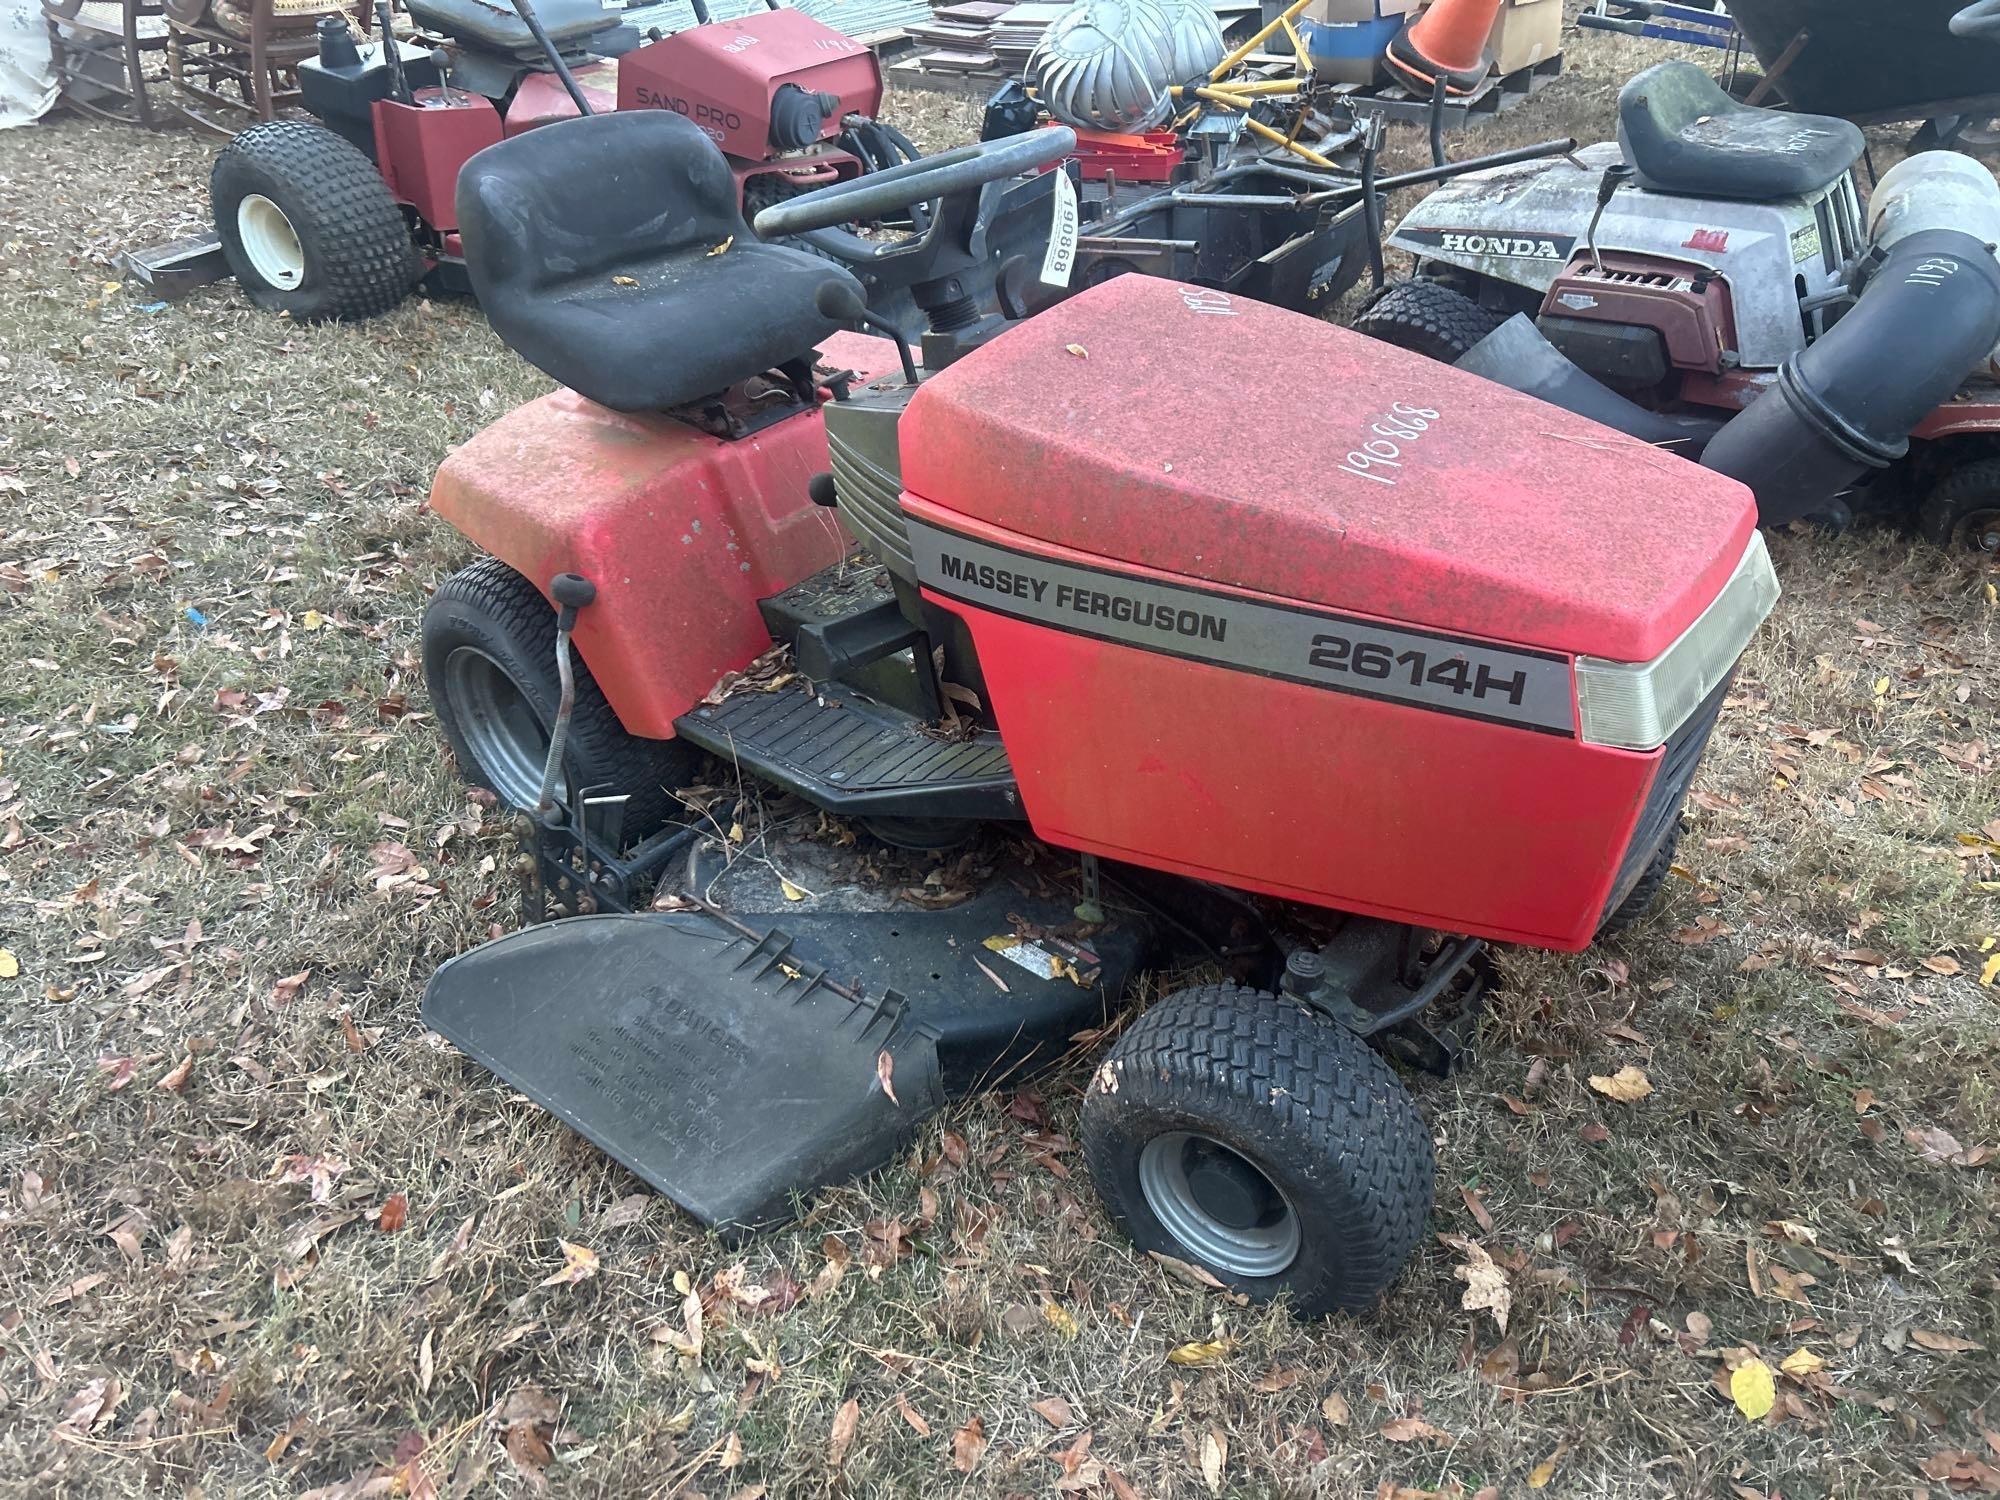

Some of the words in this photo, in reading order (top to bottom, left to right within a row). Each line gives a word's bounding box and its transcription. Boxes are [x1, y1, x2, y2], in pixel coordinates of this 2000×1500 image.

[636, 86, 690, 117] SAND
[695, 104, 741, 131] PRO
[1053, 198, 1075, 272] 190868
[1440, 234, 1560, 259] HONDA
[1904, 258, 1959, 286] 1193
[1337, 401, 1441, 485] 190868
[940, 552, 1048, 604] MASSEY
[1056, 583, 1228, 642] FERGUSON
[1307, 633, 1528, 706] 2614H
